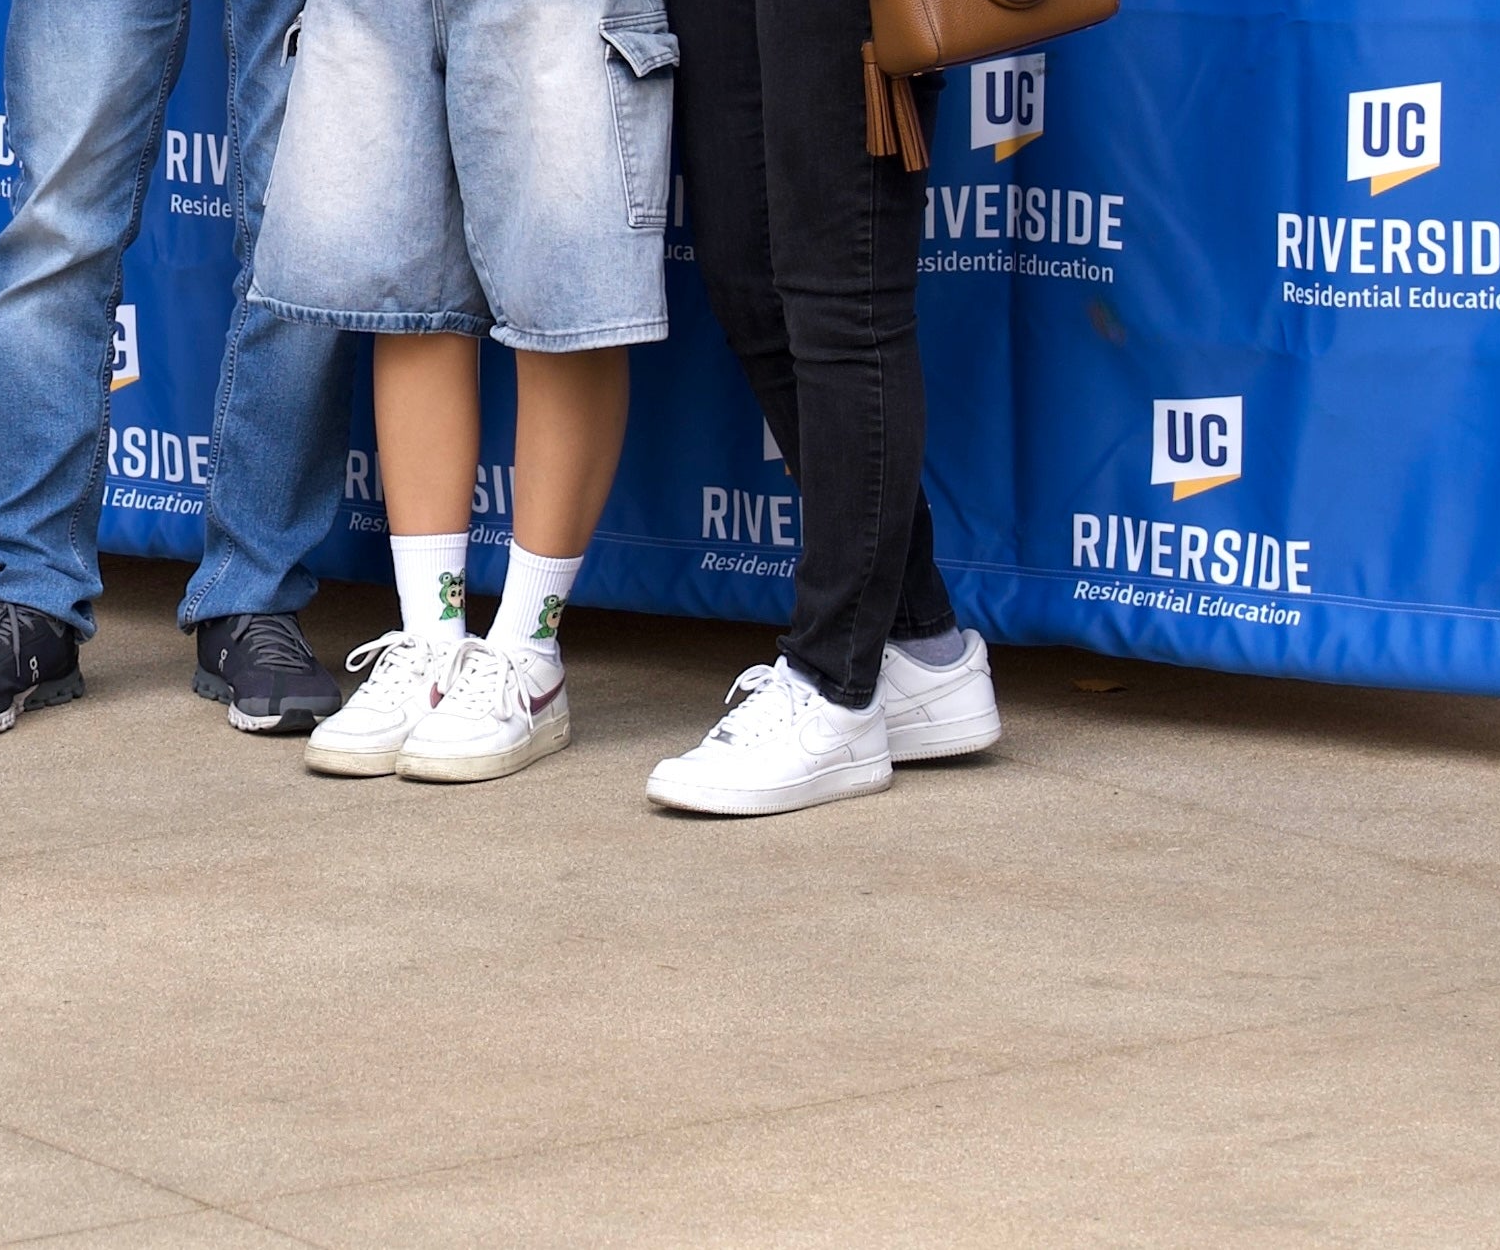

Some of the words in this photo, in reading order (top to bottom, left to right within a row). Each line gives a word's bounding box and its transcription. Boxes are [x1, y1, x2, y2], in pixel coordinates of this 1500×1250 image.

[985, 70, 1035, 127] UC
[1362, 101, 1426, 159] UC
[171, 193, 232, 218] Reside
[925, 185, 1123, 254] IVERSIDE
[917, 249, 1016, 272] esidential
[1020, 254, 1113, 283] Education
[1284, 282, 1401, 308] Residential
[1167, 409, 1228, 468] UC
[112, 488, 203, 516] Education
[700, 551, 795, 579] Residenti
[1074, 514, 1311, 594] RIVERSIDE
[1074, 581, 1192, 613] Residential
[1198, 596, 1301, 625] Education
